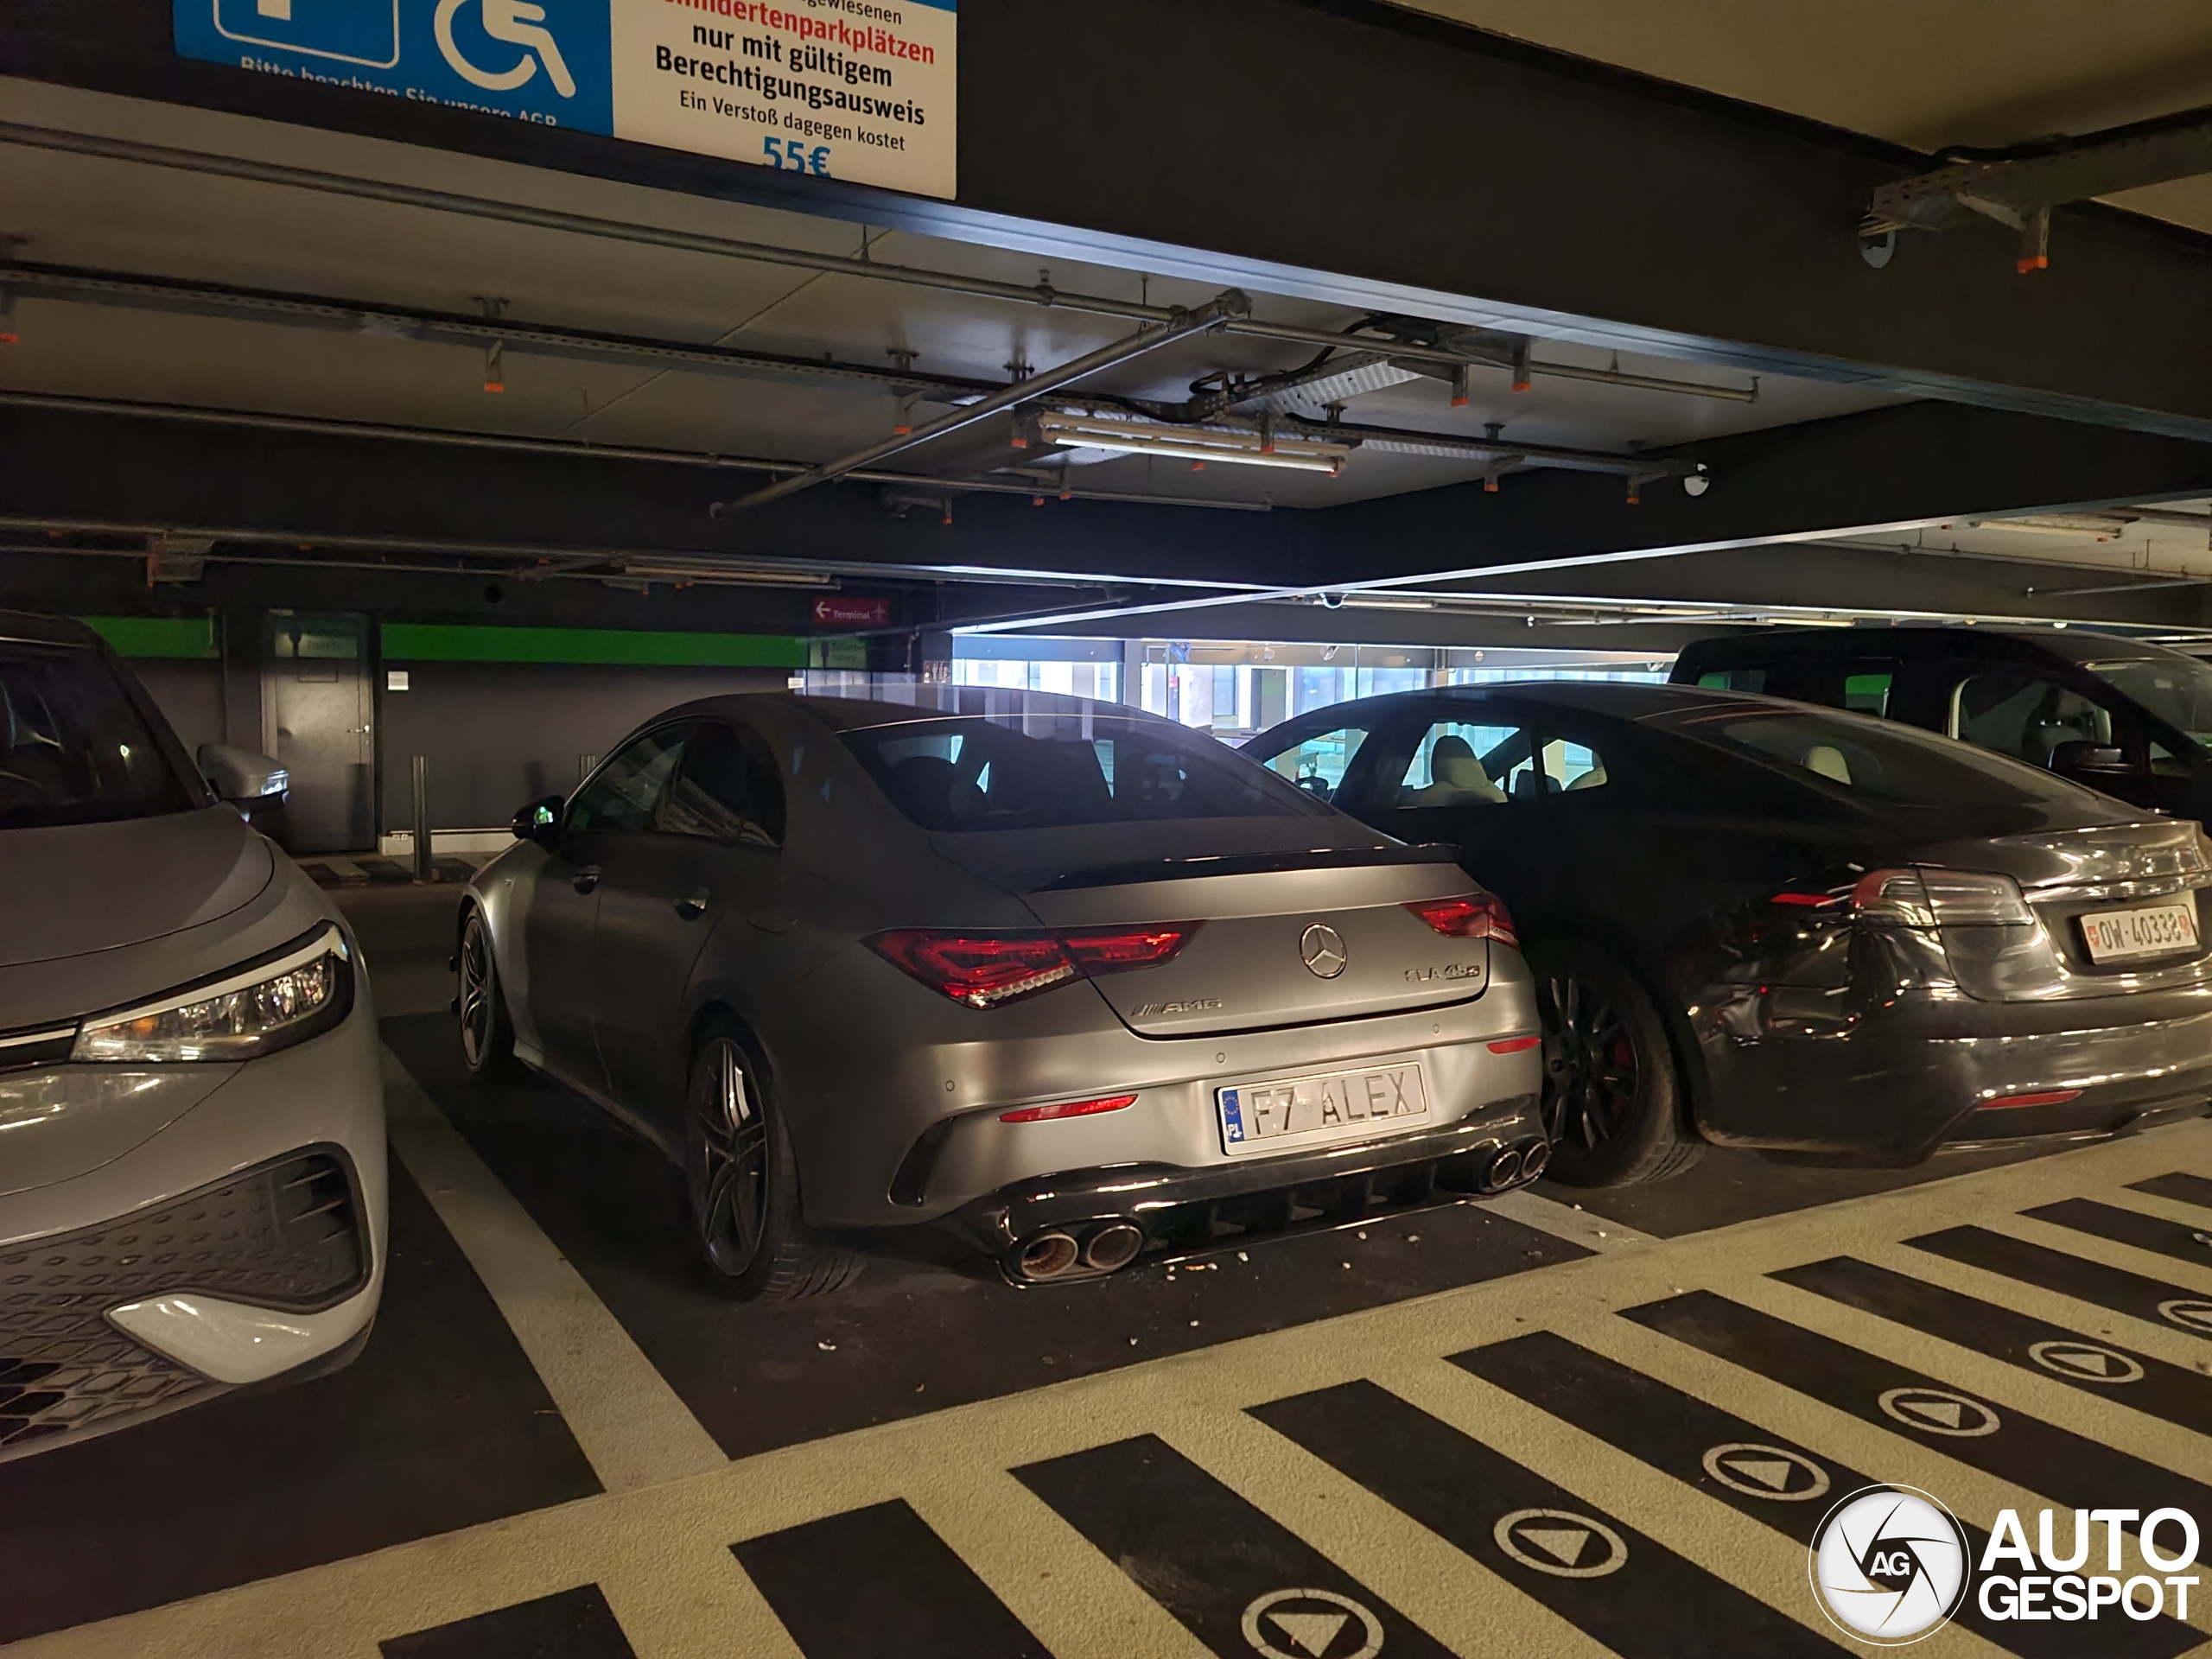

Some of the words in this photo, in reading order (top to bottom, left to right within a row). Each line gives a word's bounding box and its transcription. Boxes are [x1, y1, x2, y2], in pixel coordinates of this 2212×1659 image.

[693, 24, 734, 51] nur
[742, 35, 782, 62] mit
[789, 43, 892, 87] gültigem
[656, 45, 925, 125] Berechtigungsausweis
[680, 90, 707, 111] Ein
[713, 96, 779, 125] Verstoß
[784, 112, 852, 141] dagegen
[857, 125, 906, 150] kostet
[763, 136, 831, 177] 55€
[832, 610, 871, 620] Terminal
[1404, 967, 1442, 982] CLA
[1160, 999, 1222, 1014] AMG
[1251, 1087, 1295, 1135] F7
[1322, 1071, 1411, 1125] ALEX
[1227, 1123, 1243, 1138] PL
